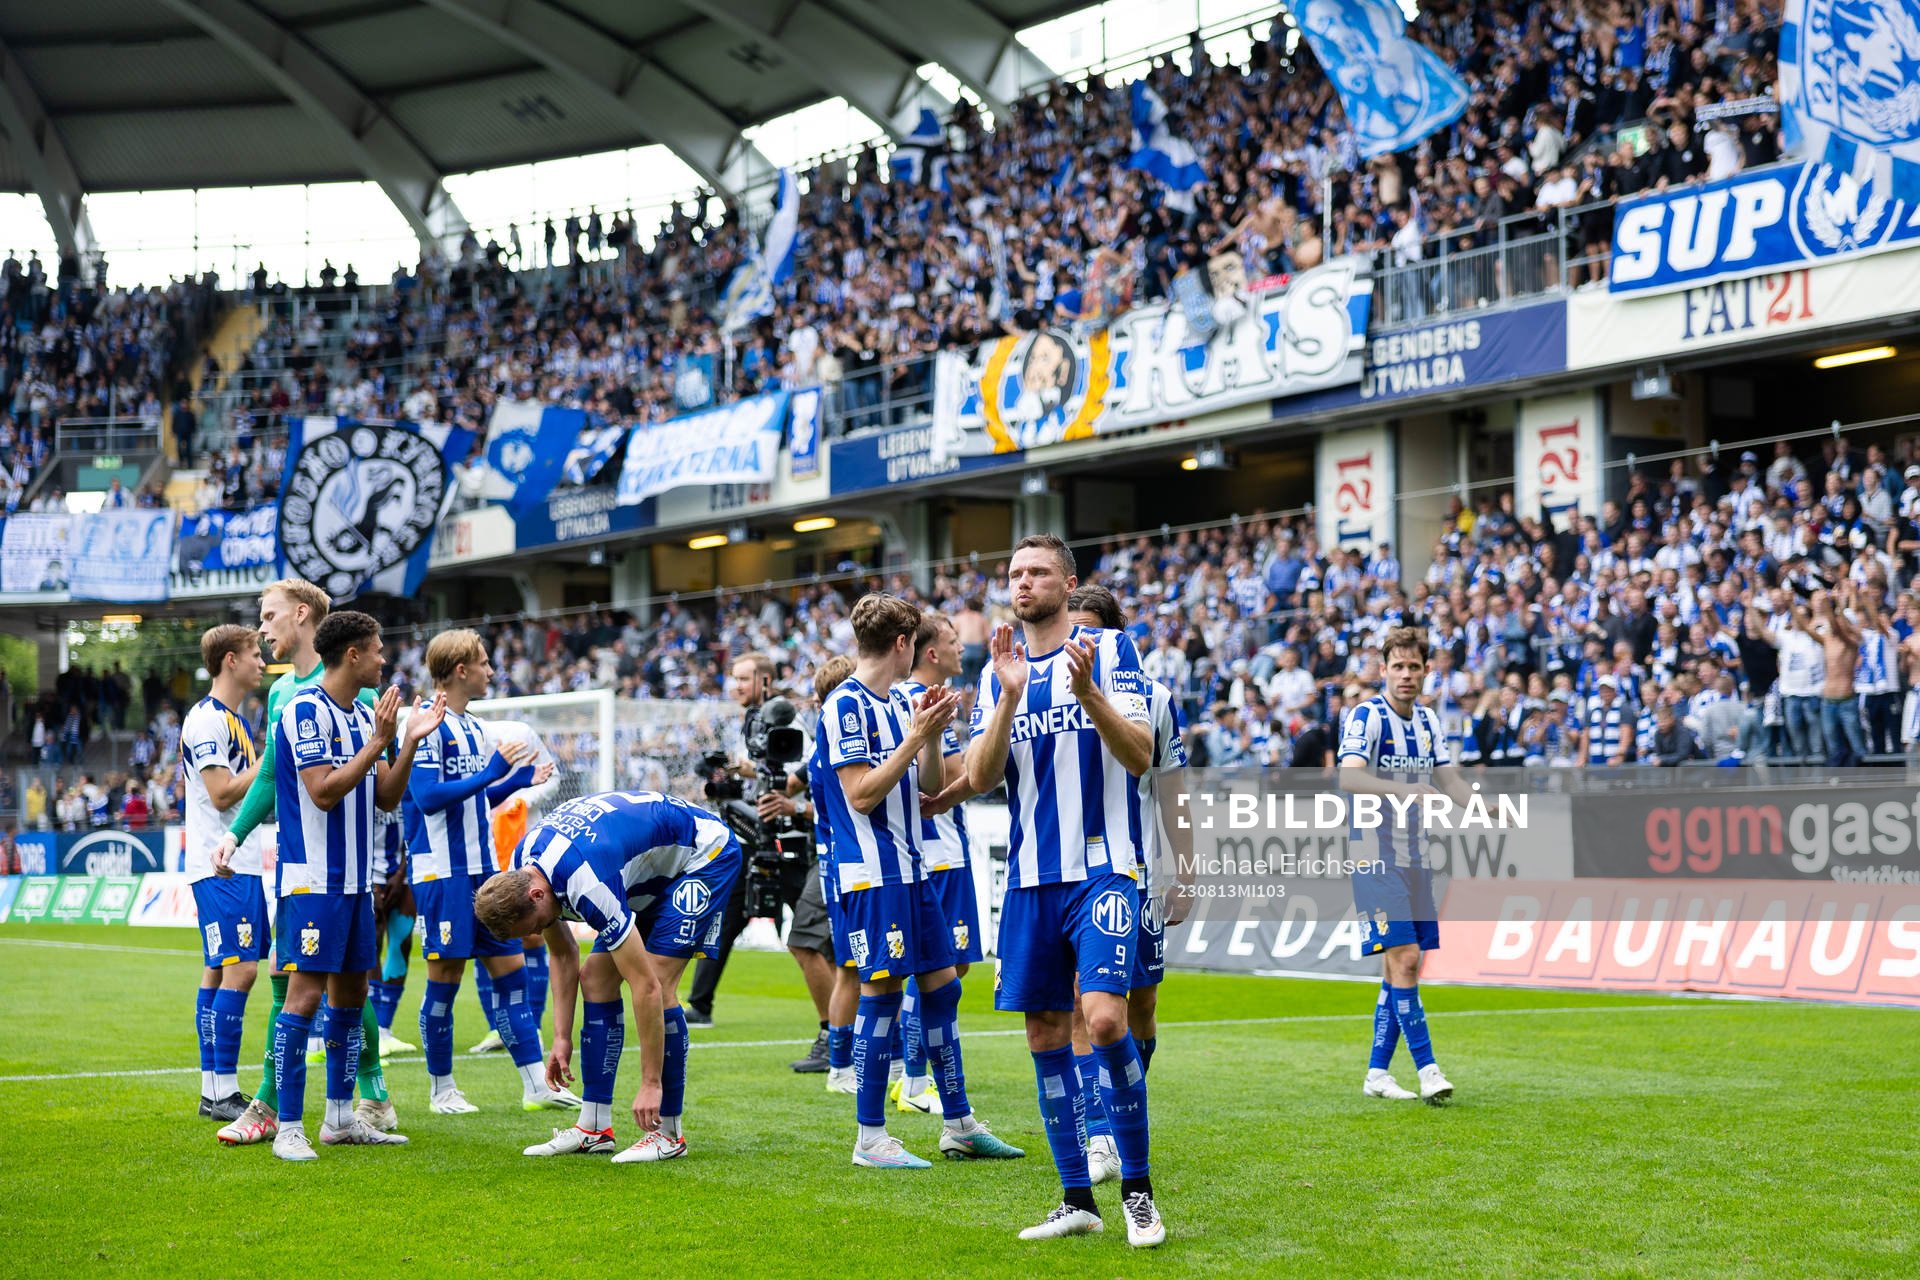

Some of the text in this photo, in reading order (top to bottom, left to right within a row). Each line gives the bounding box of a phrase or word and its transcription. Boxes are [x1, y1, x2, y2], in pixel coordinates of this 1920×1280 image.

[1611, 178, 1786, 284] SUP
[1373, 321, 1481, 365] GENDENS
[296, 741, 324, 752] UNIBET
[841, 739, 866, 749] UNIBET
[446, 754, 486, 775] SERNE
[680, 919, 696, 938] 21
[1486, 894, 1920, 978] BAUHAUS
[1114, 944, 1126, 966] 9
